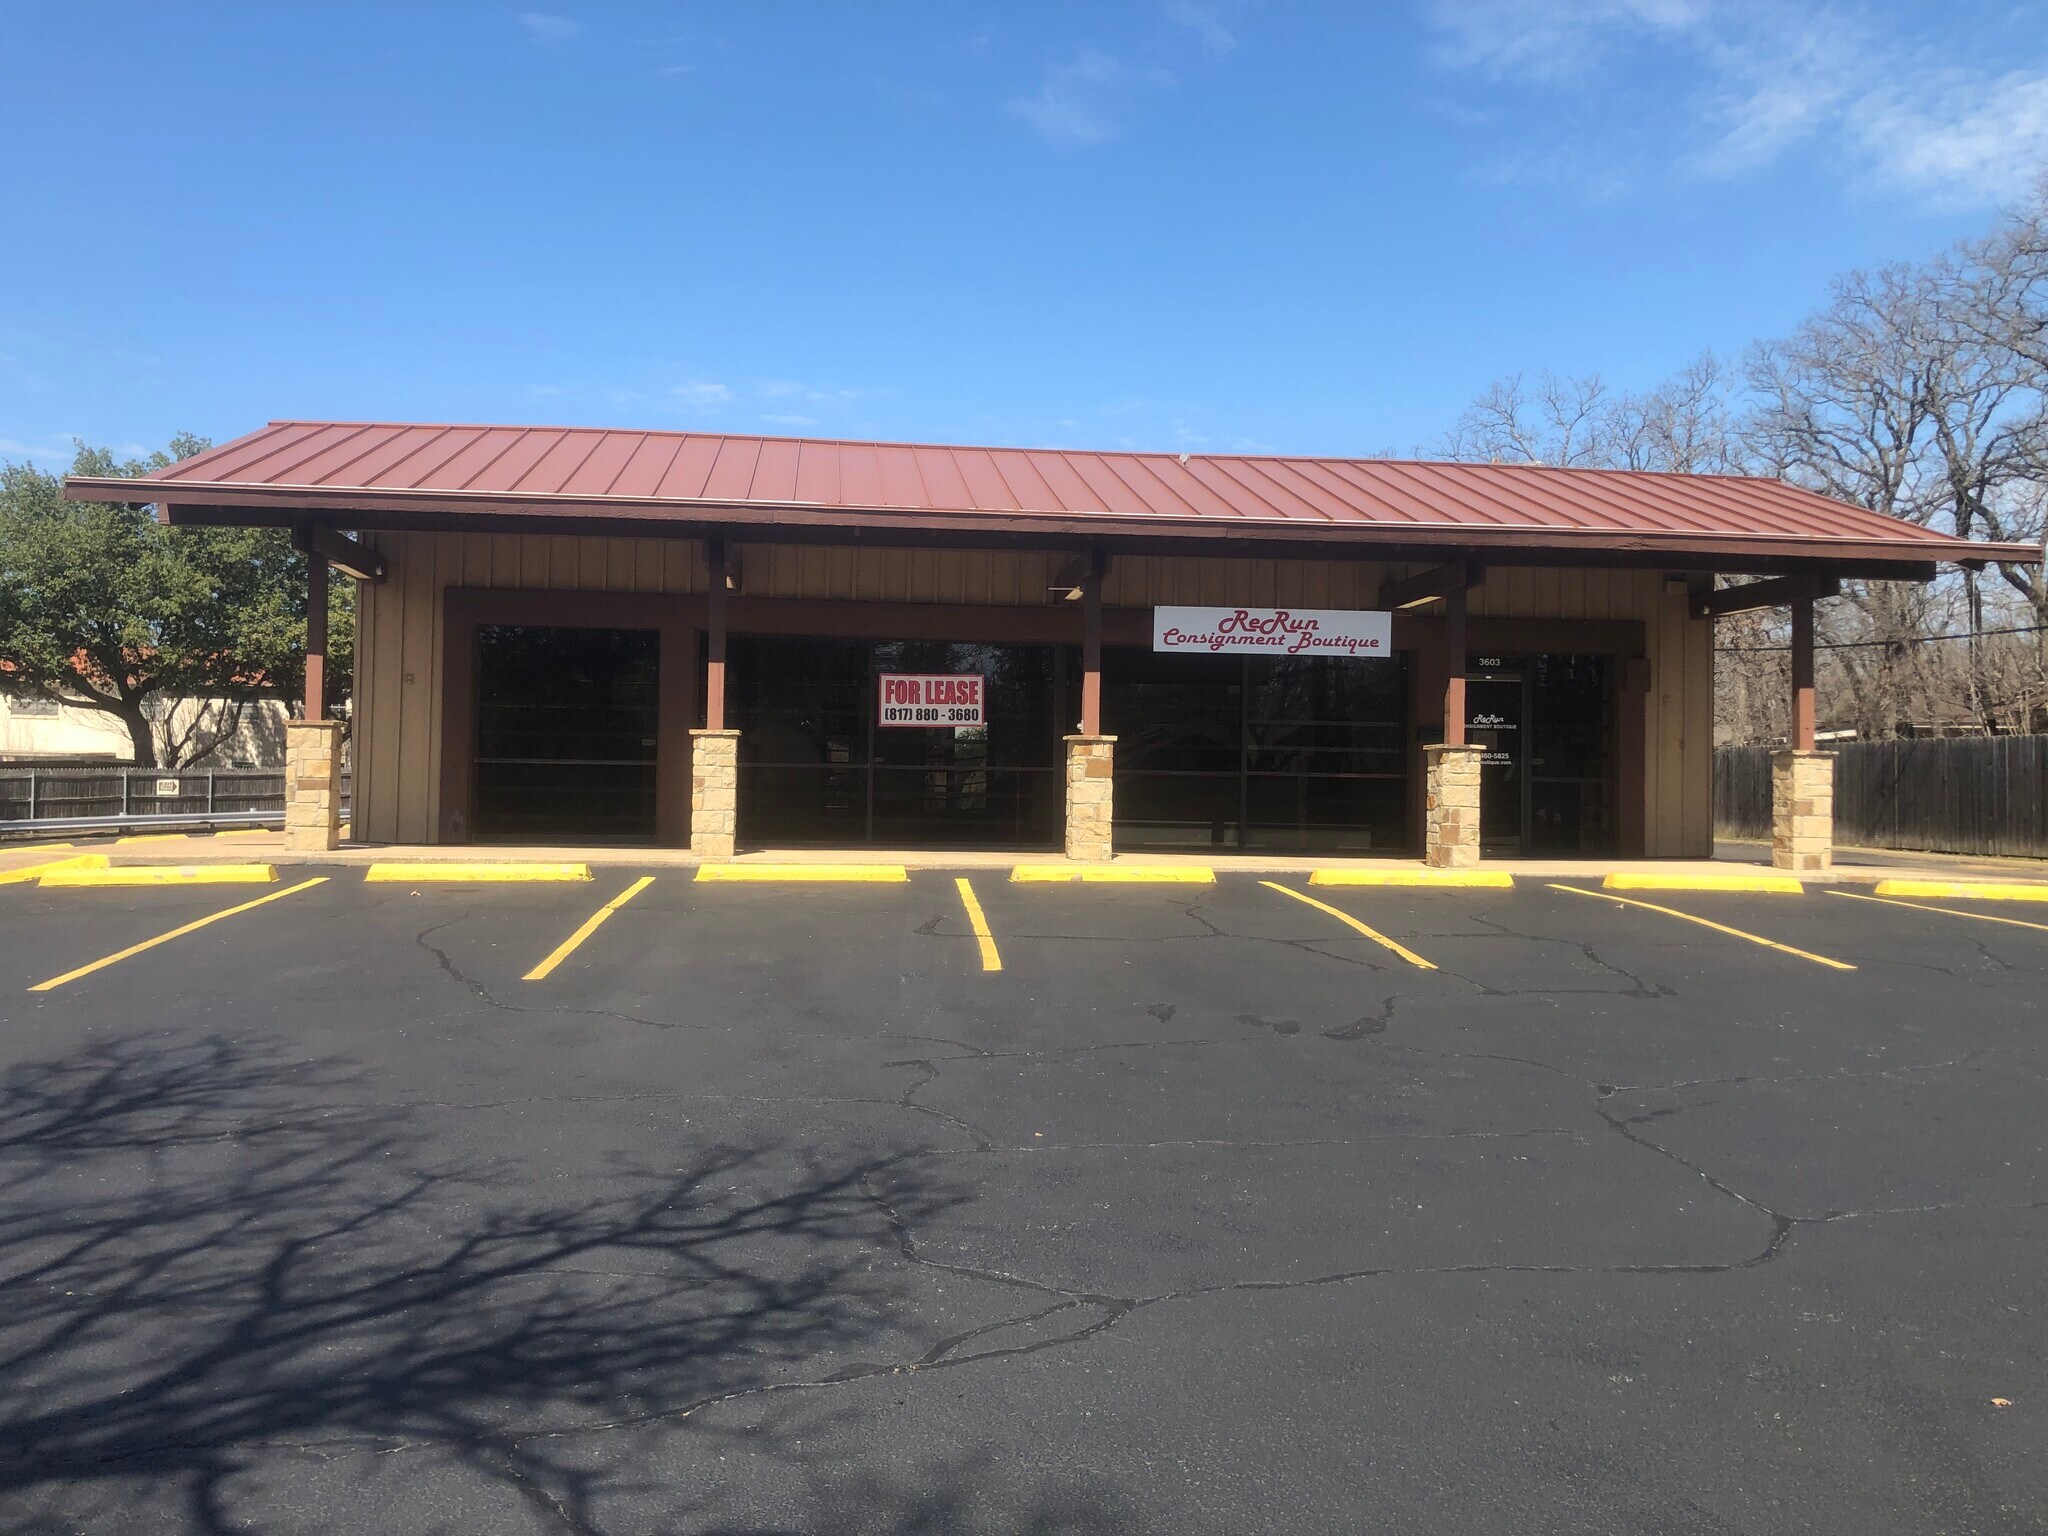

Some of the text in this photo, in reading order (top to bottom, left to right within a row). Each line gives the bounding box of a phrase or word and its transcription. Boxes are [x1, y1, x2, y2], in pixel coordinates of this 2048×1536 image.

[1218, 610, 1320, 635] ReRun
[1163, 628, 1380, 654] Consignment Boutique
[1479, 658, 1500, 666] 3603
[885, 680, 979, 705] FOR LEASE
[884, 708, 912, 720] (817)
[915, 708, 938, 721] 880
[948, 708, 979, 721] 3680
[1473, 714, 1504, 723] ReRun
